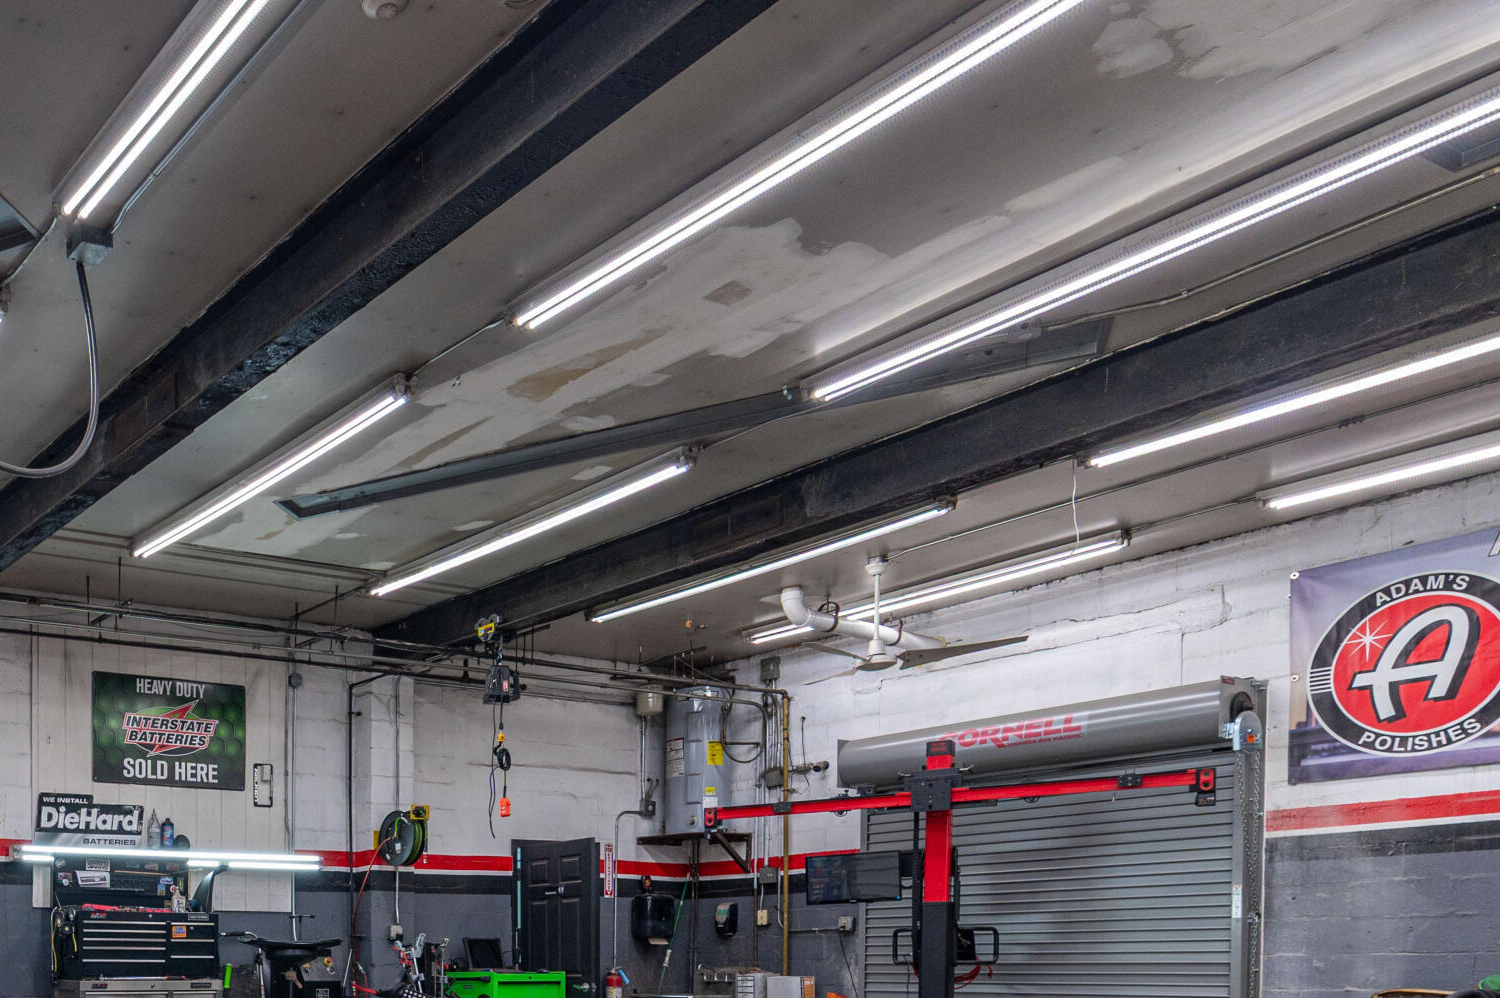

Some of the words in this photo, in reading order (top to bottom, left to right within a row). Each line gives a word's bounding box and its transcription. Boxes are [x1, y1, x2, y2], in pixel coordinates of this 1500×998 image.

[1375, 574, 1471, 607] ADAM'S
[136, 678, 172, 696] HEAVY
[176, 682, 205, 699] DUTY
[125, 715, 213, 733] INTERSTATE
[1358, 718, 1482, 752] POLISHES
[128, 730, 207, 747] BATTERIES
[123, 758, 168, 781] SOLD
[174, 762, 218, 783] HERE
[40, 805, 140, 831] DieHard
[83, 838, 136, 846] BATTERIES
